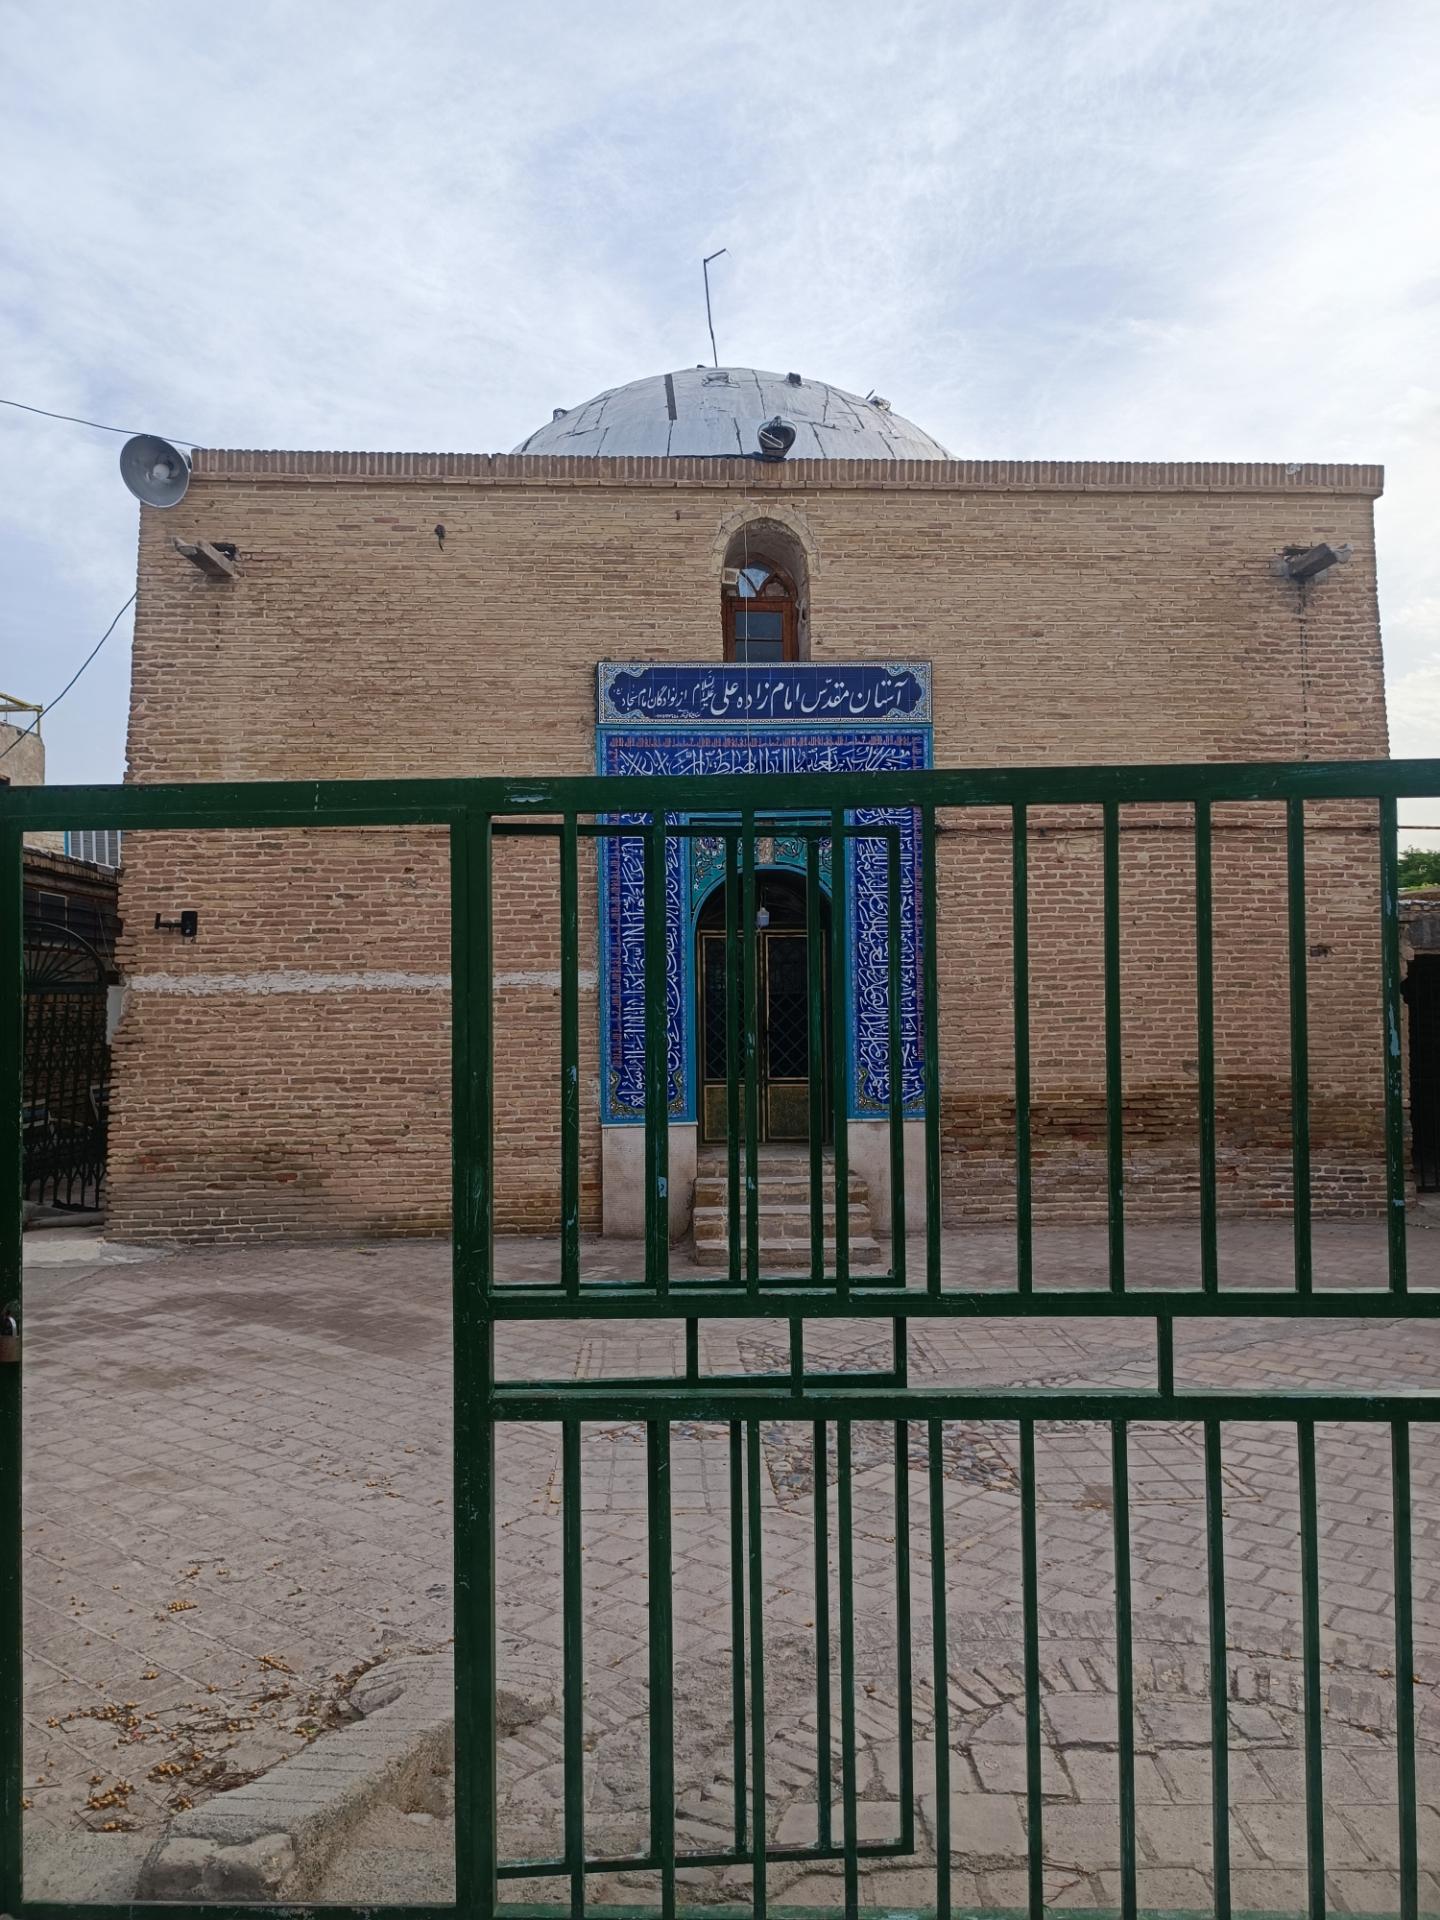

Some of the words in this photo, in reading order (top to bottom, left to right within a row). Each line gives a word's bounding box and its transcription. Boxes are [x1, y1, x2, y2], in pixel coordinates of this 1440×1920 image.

[647, 685, 676, 709] نوادگان
[675, 689, 688, 707] از
[710, 680, 739, 715] علی
[849, 677, 909, 713] آستان
